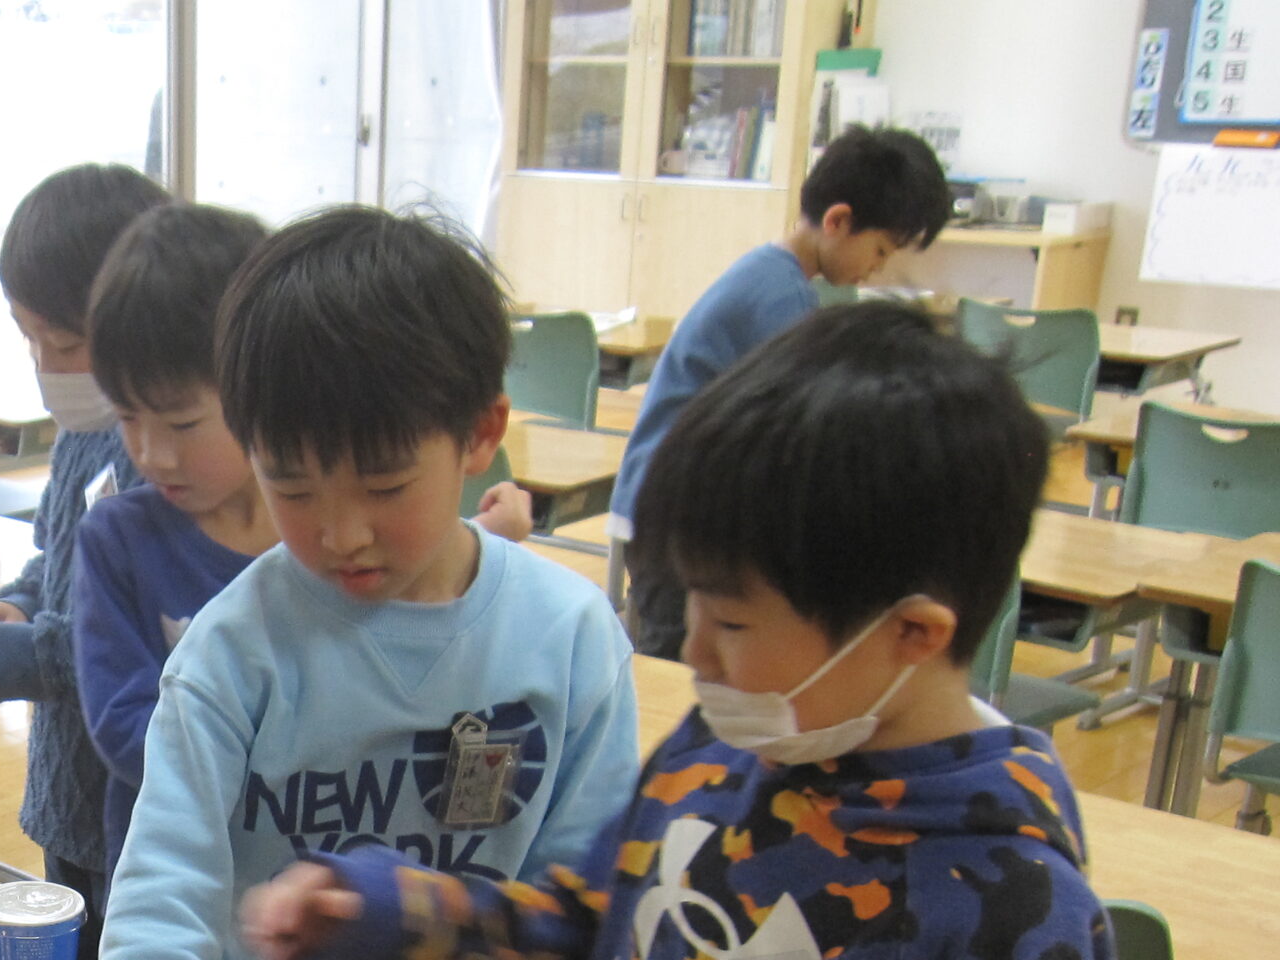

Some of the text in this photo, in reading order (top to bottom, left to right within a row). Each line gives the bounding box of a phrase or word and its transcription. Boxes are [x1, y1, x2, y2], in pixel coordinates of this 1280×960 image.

[1207, 0, 1224, 21] 2
[1202, 29, 1220, 50] 3
[1195, 60, 1246, 81] 4 国
[1192, 90, 1210, 112] 5
[243, 758, 408, 836] NEW
